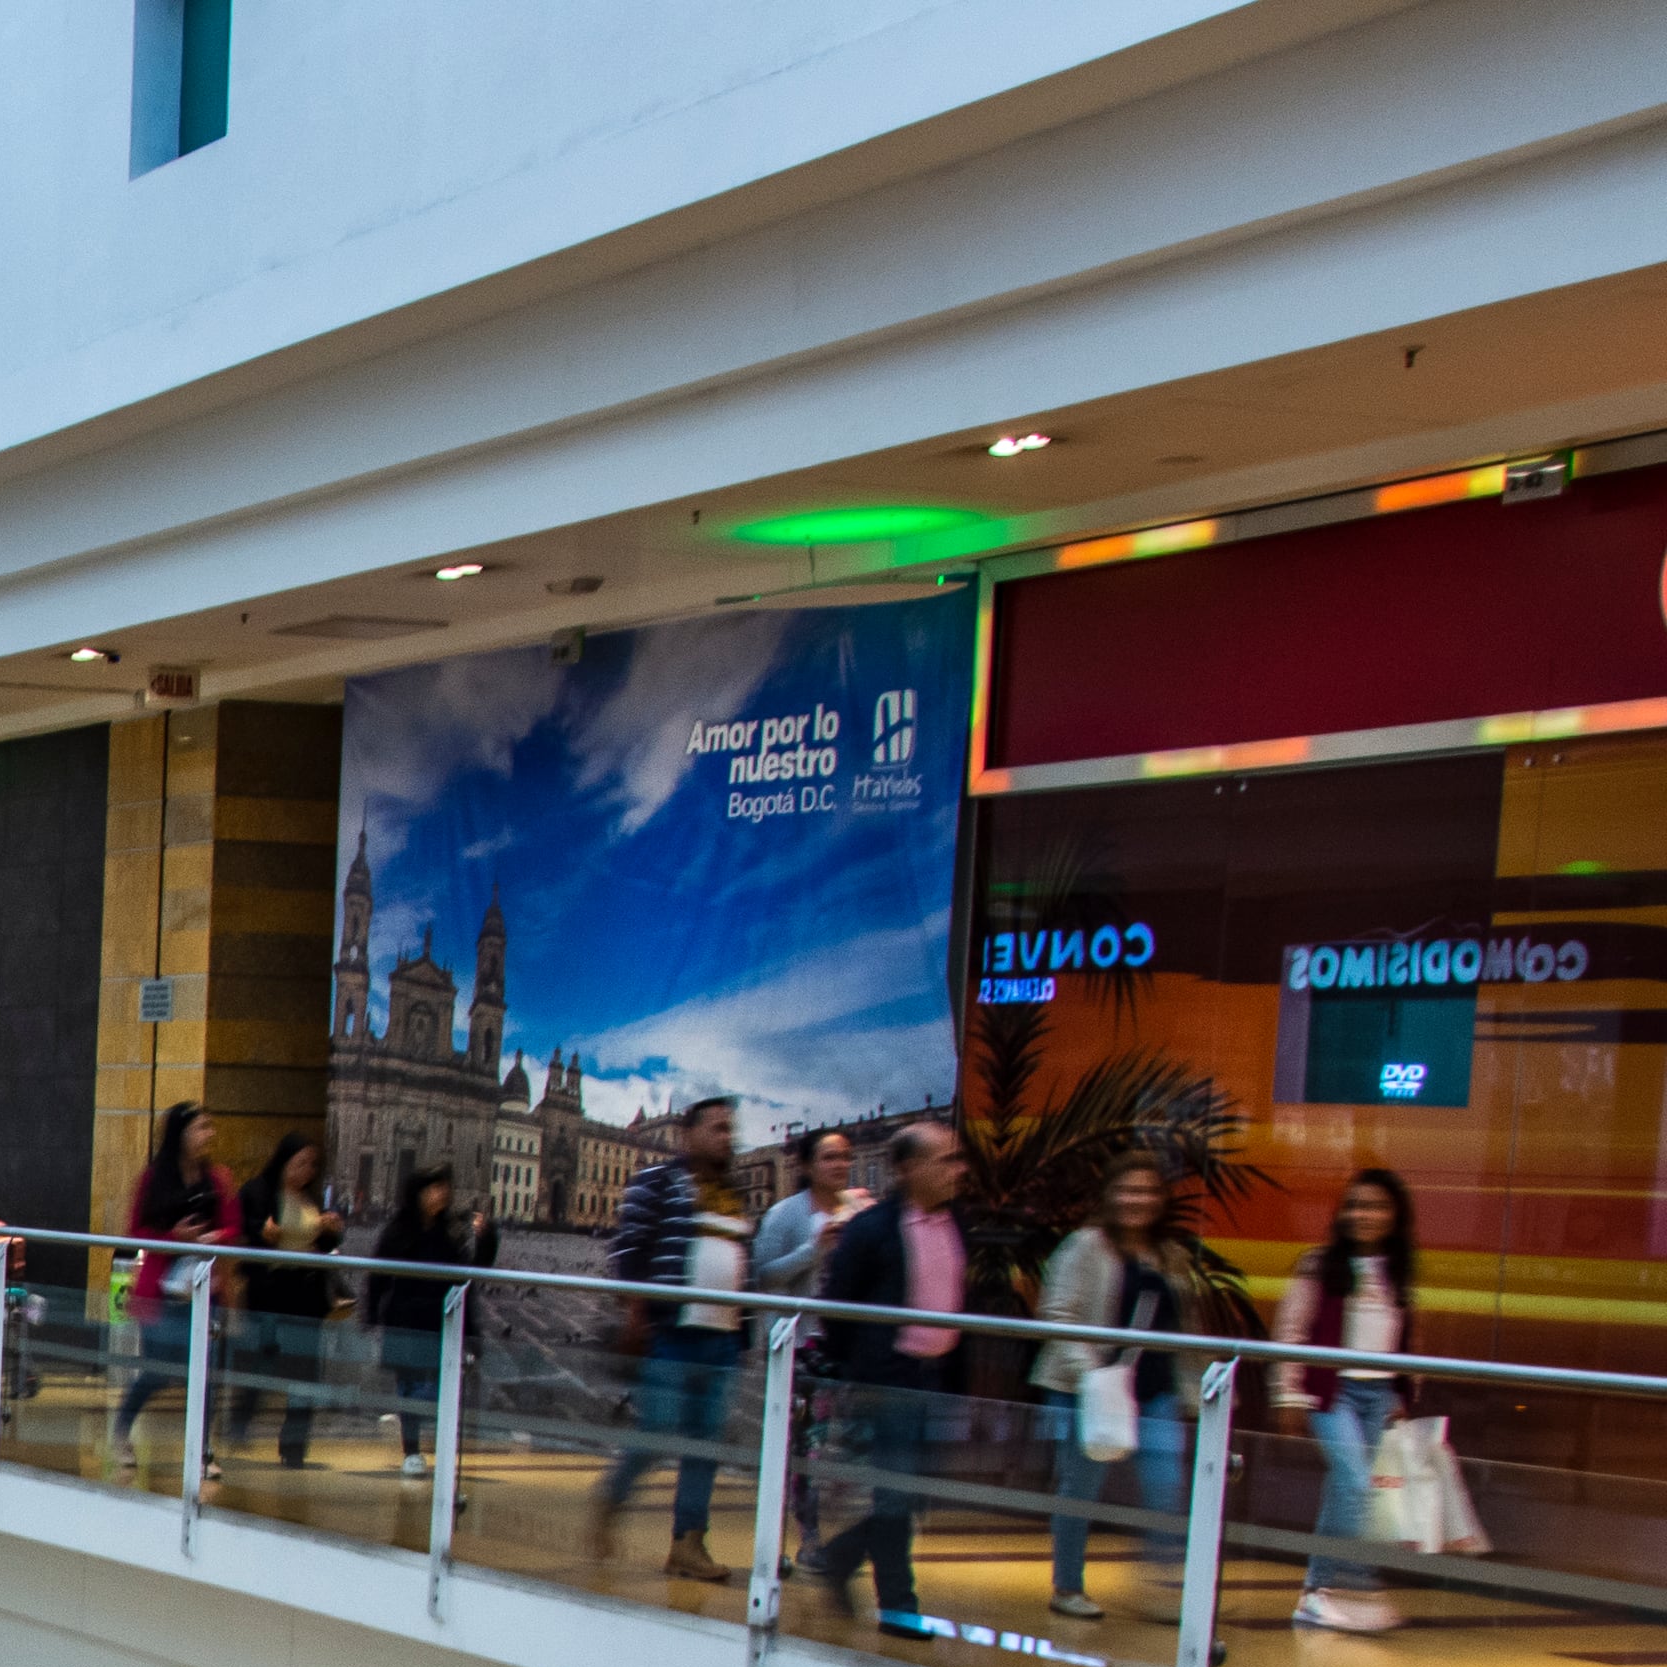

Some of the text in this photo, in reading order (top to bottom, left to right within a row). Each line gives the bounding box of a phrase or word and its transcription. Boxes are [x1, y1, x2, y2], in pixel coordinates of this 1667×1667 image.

[687, 703, 840, 761] Amor por lo
[729, 746, 838, 785] nuestro
[728, 784, 837, 824] Bogotá D.C.
[1381, 1063, 1428, 1080] DVD
